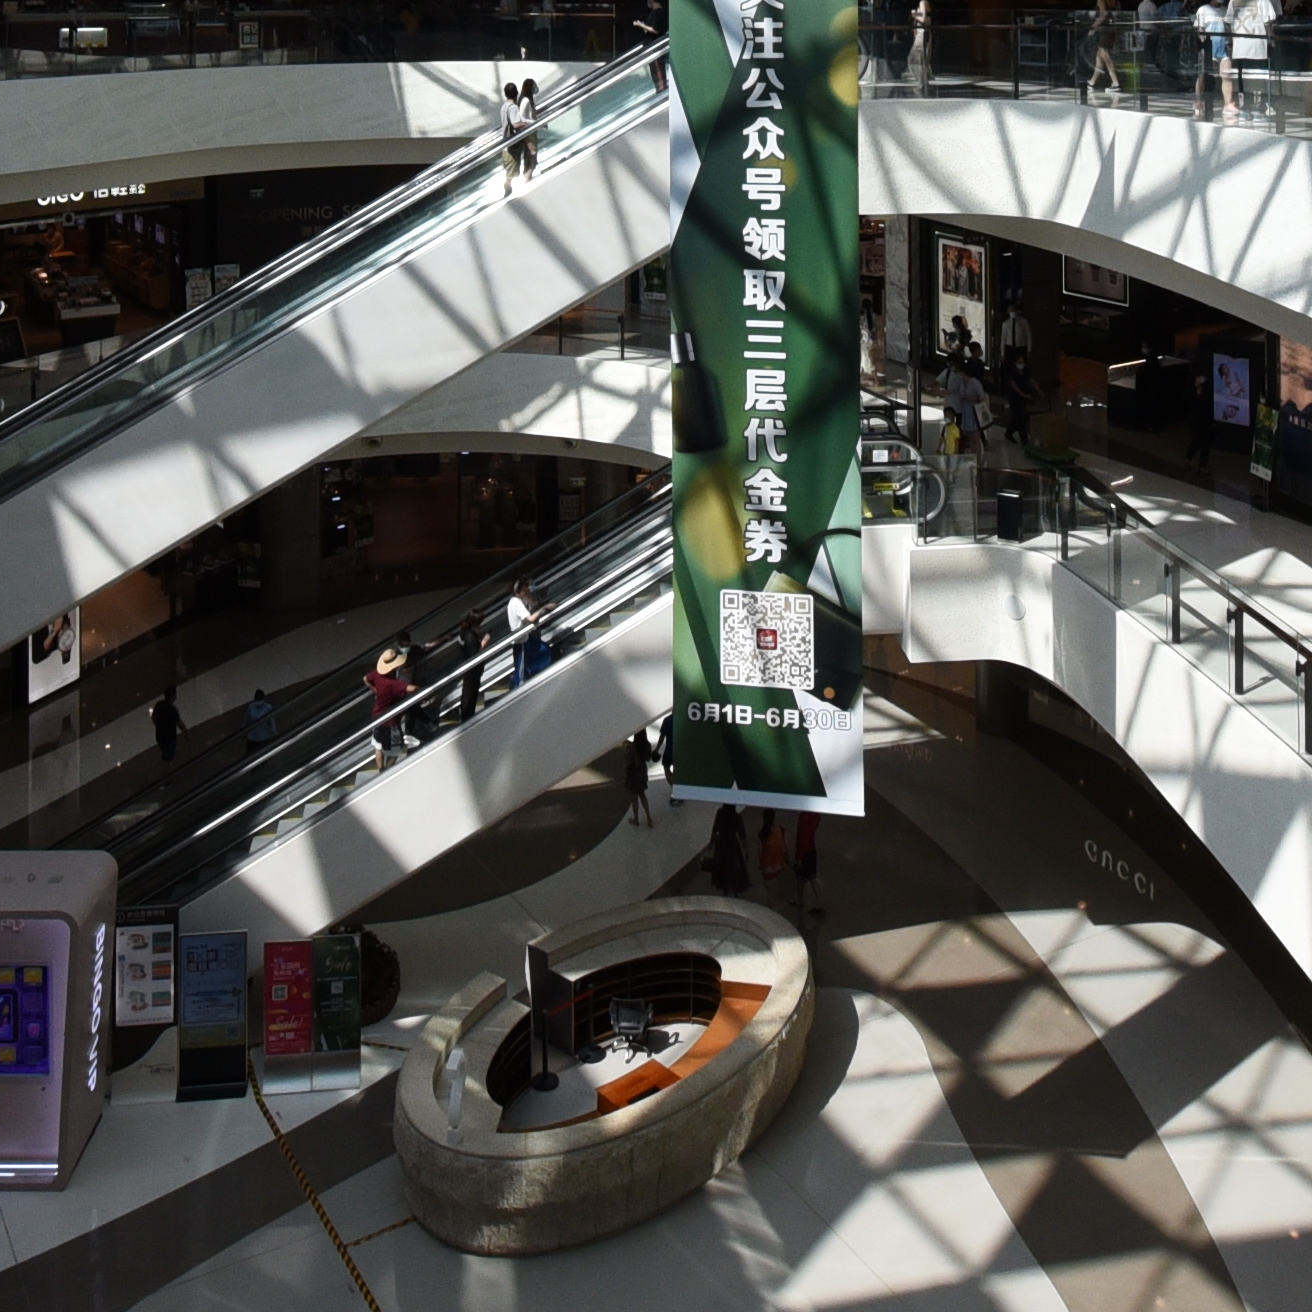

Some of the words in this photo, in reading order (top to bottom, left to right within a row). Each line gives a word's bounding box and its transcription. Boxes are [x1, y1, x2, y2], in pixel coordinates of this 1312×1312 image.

[259, 205, 334, 223] OPENING
[687, 701, 853, 731] 6月1日-6月30日
[91, 922, 106, 1034] BINGO
[87, 1034, 100, 1092] VIP
